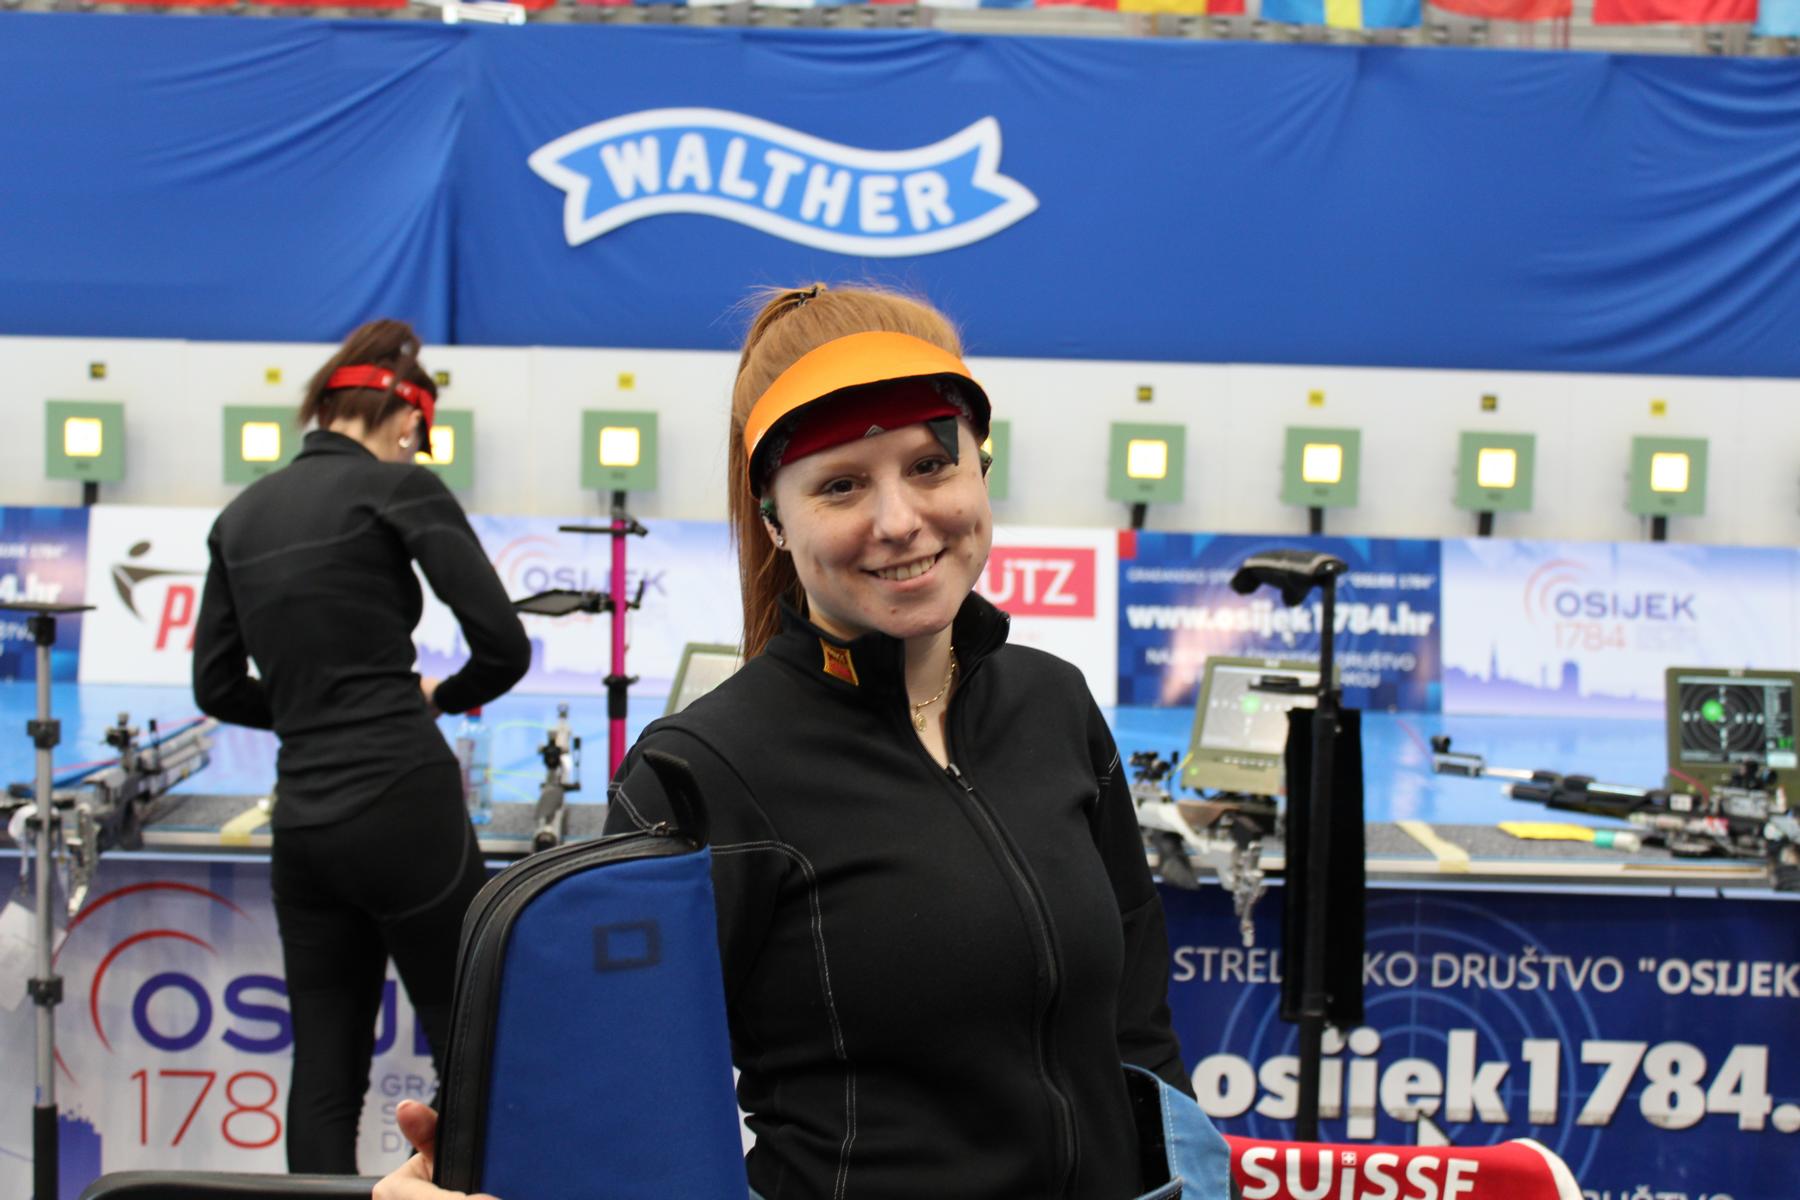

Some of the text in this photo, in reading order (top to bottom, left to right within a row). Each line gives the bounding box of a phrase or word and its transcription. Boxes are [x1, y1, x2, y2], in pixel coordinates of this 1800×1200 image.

[600, 131, 955, 233] WALTHER
[1555, 589, 1697, 622] OSIJEK
[1554, 622, 1626, 651] 1784
[1431, 946, 1625, 994] DRUŠTVO
